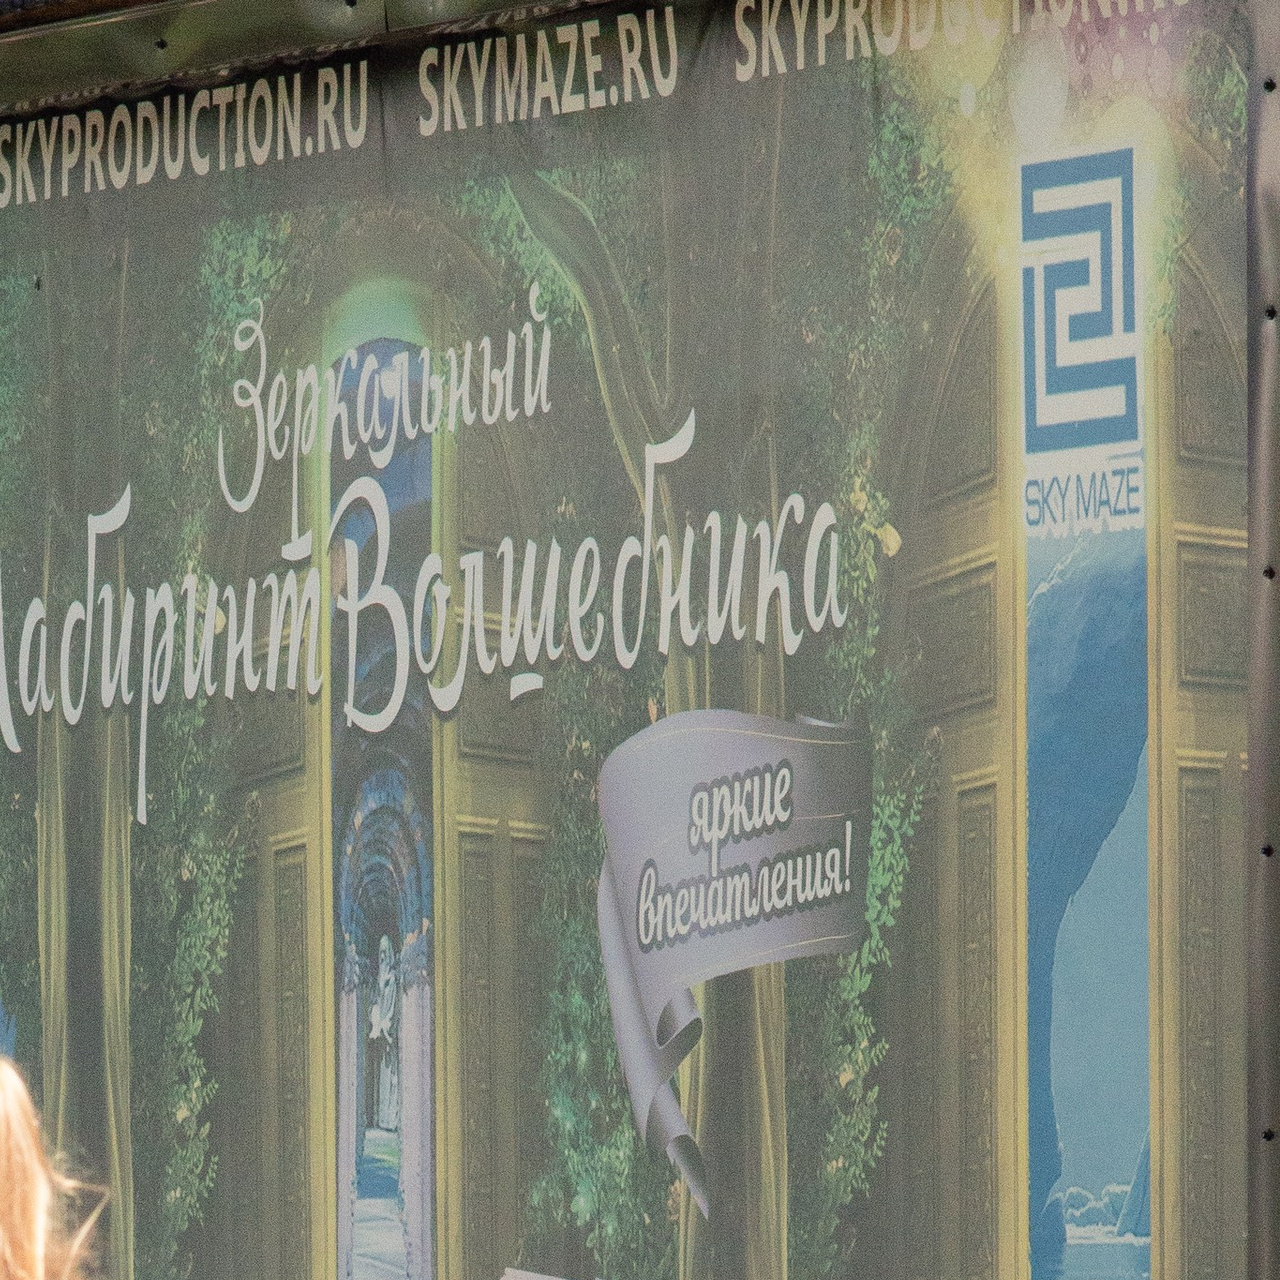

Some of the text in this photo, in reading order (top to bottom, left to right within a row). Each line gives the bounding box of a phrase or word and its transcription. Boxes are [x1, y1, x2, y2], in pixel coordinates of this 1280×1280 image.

[419, 8, 678, 137] SKYMAZE.RU
[218, 281, 551, 560] Зеркальный
[1025, 466, 1140, 526] SKY MAZE
[327, 407, 850, 734] Волшебника
[638, 820, 852, 945] впечатления!
[690, 767, 792, 877] яркие
